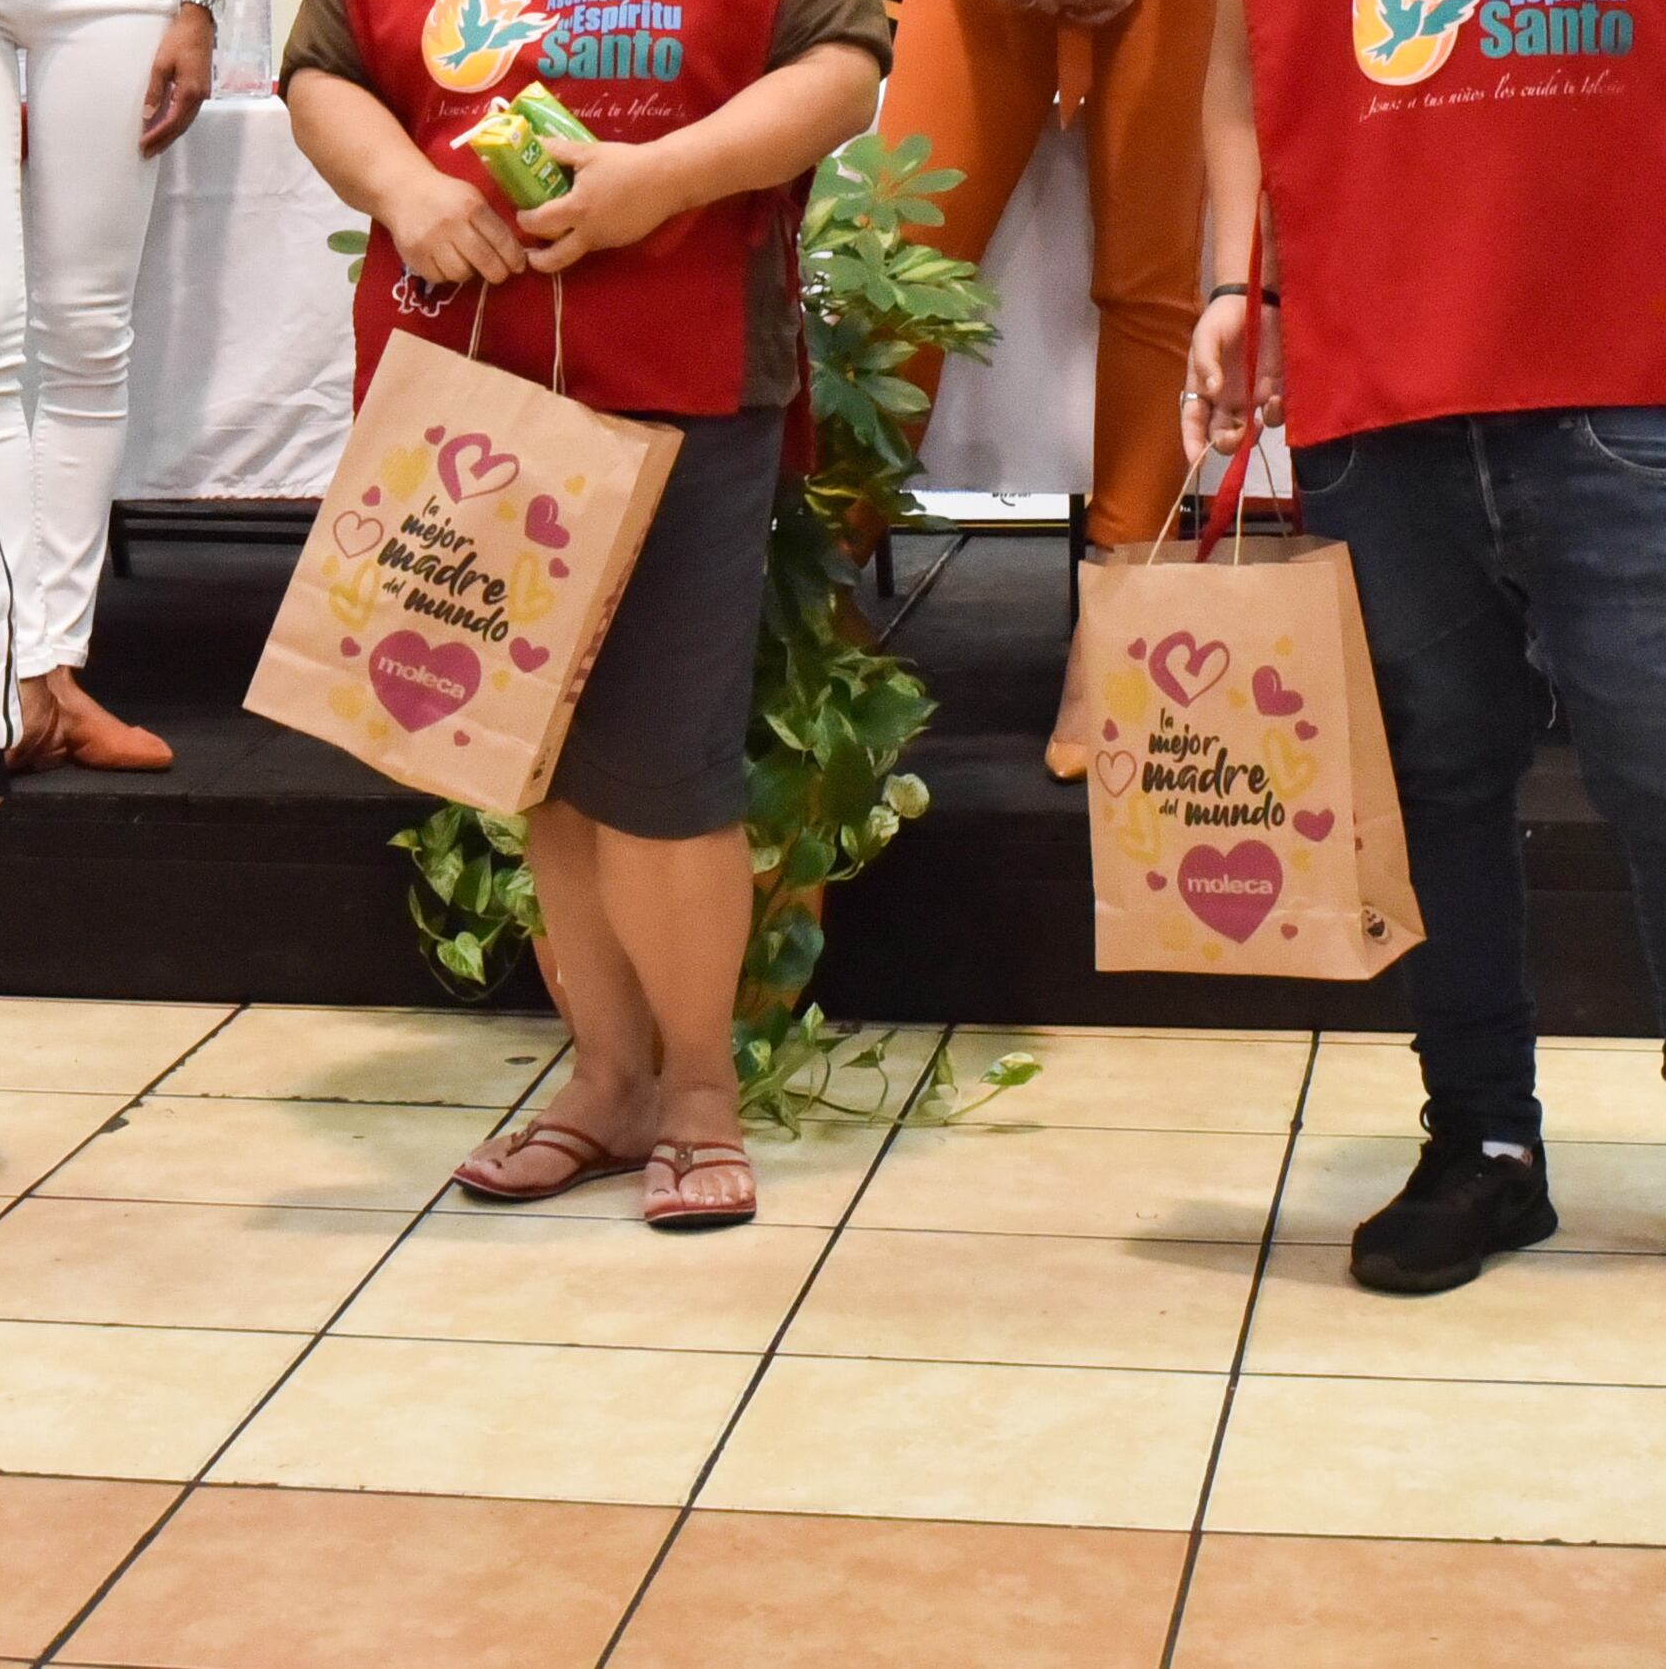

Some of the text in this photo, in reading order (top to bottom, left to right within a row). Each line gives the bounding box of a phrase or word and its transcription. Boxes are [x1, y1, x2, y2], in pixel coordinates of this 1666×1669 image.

[1478, 0, 1632, 58] Santo
[536, 29, 683, 82] Santo
[422, 494, 440, 517] la
[400, 513, 474, 553] mejor
[377, 537, 508, 605] madre
[382, 577, 508, 642] del mundo
[377, 656, 466, 699] moleca
[1159, 707, 1174, 731] la
[1147, 722, 1219, 762] mejor
[1140, 746, 1270, 799] madre
[1158, 790, 1285, 831] del mundo
[1186, 873, 1273, 895] moleca
